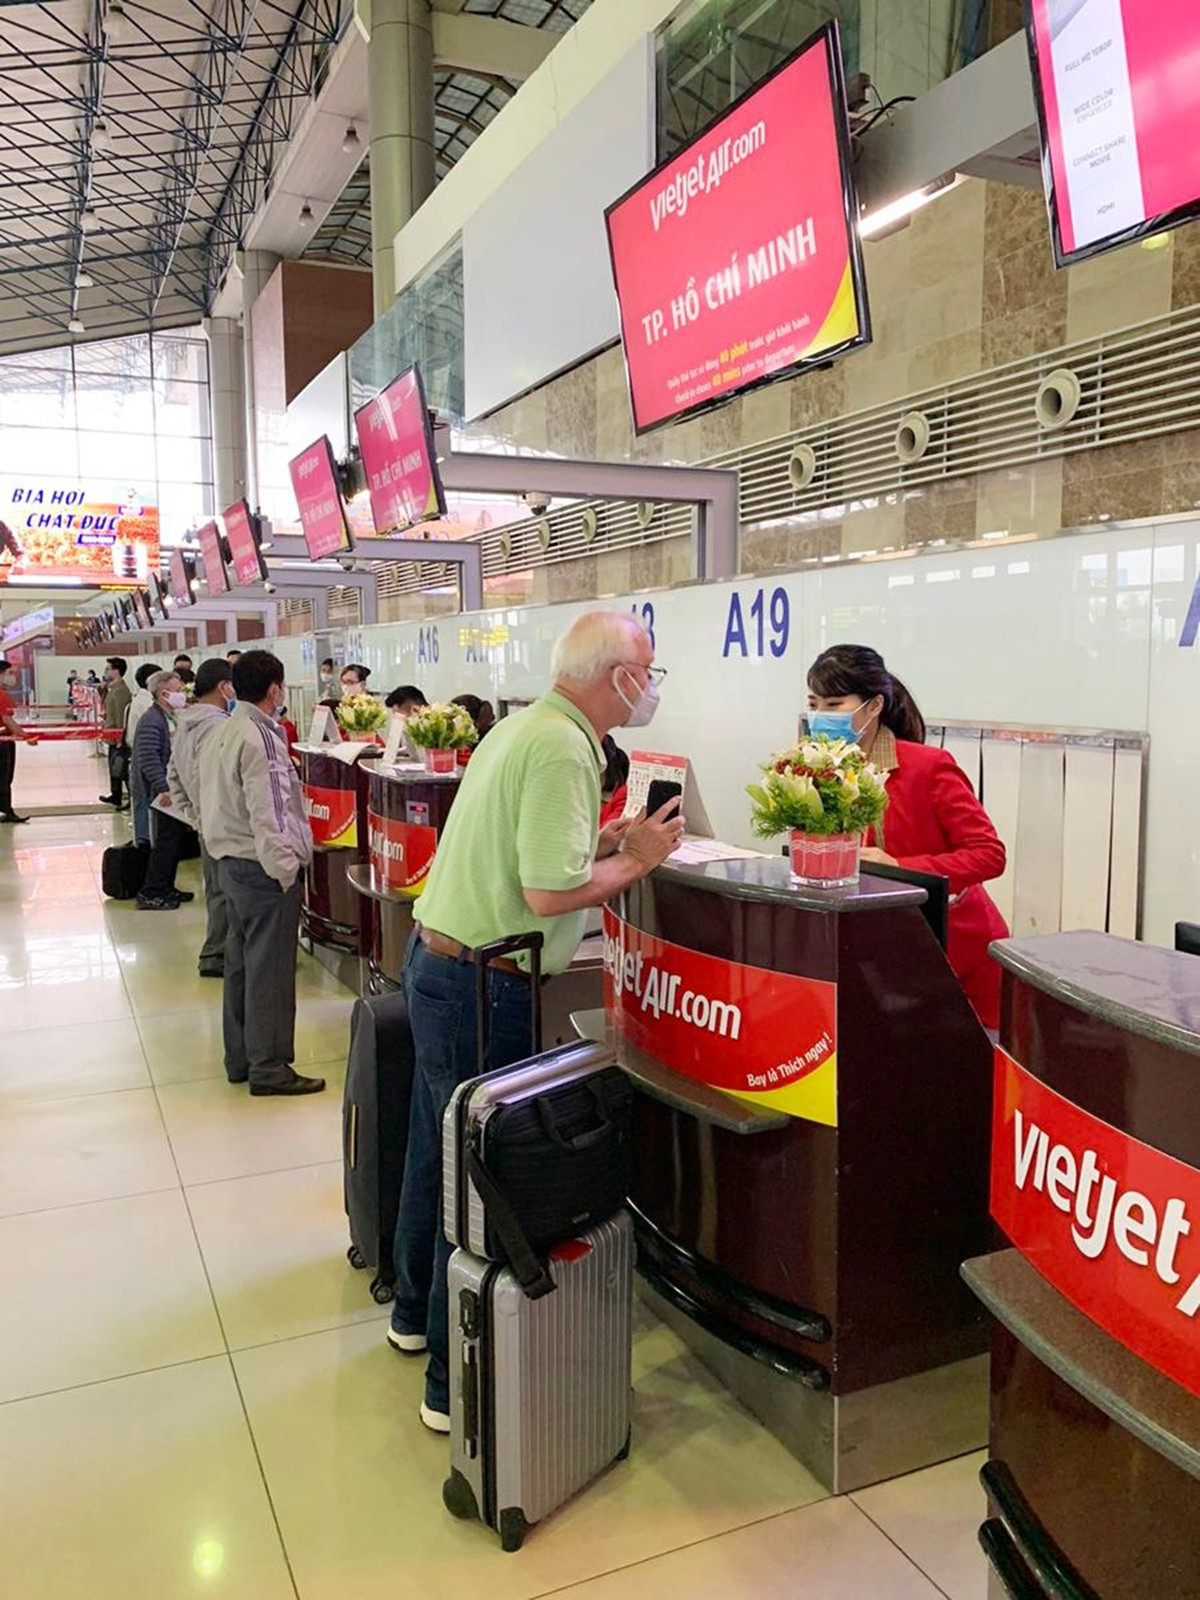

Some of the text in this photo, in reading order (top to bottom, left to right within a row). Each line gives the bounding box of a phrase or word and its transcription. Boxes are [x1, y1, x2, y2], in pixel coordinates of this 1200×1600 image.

[1091, 87, 1114, 107] COLOR
[1089, 154, 1111, 169] MOVIE
[1097, 202, 1116, 216] HDMI
[642, 217, 817, 346] TP. HỒ CHÍ MINH
[11, 488, 44, 504] BIA
[722, 586, 790, 659] A19
[418, 625, 440, 664] A16
[746, 1073, 767, 1088] Bay
